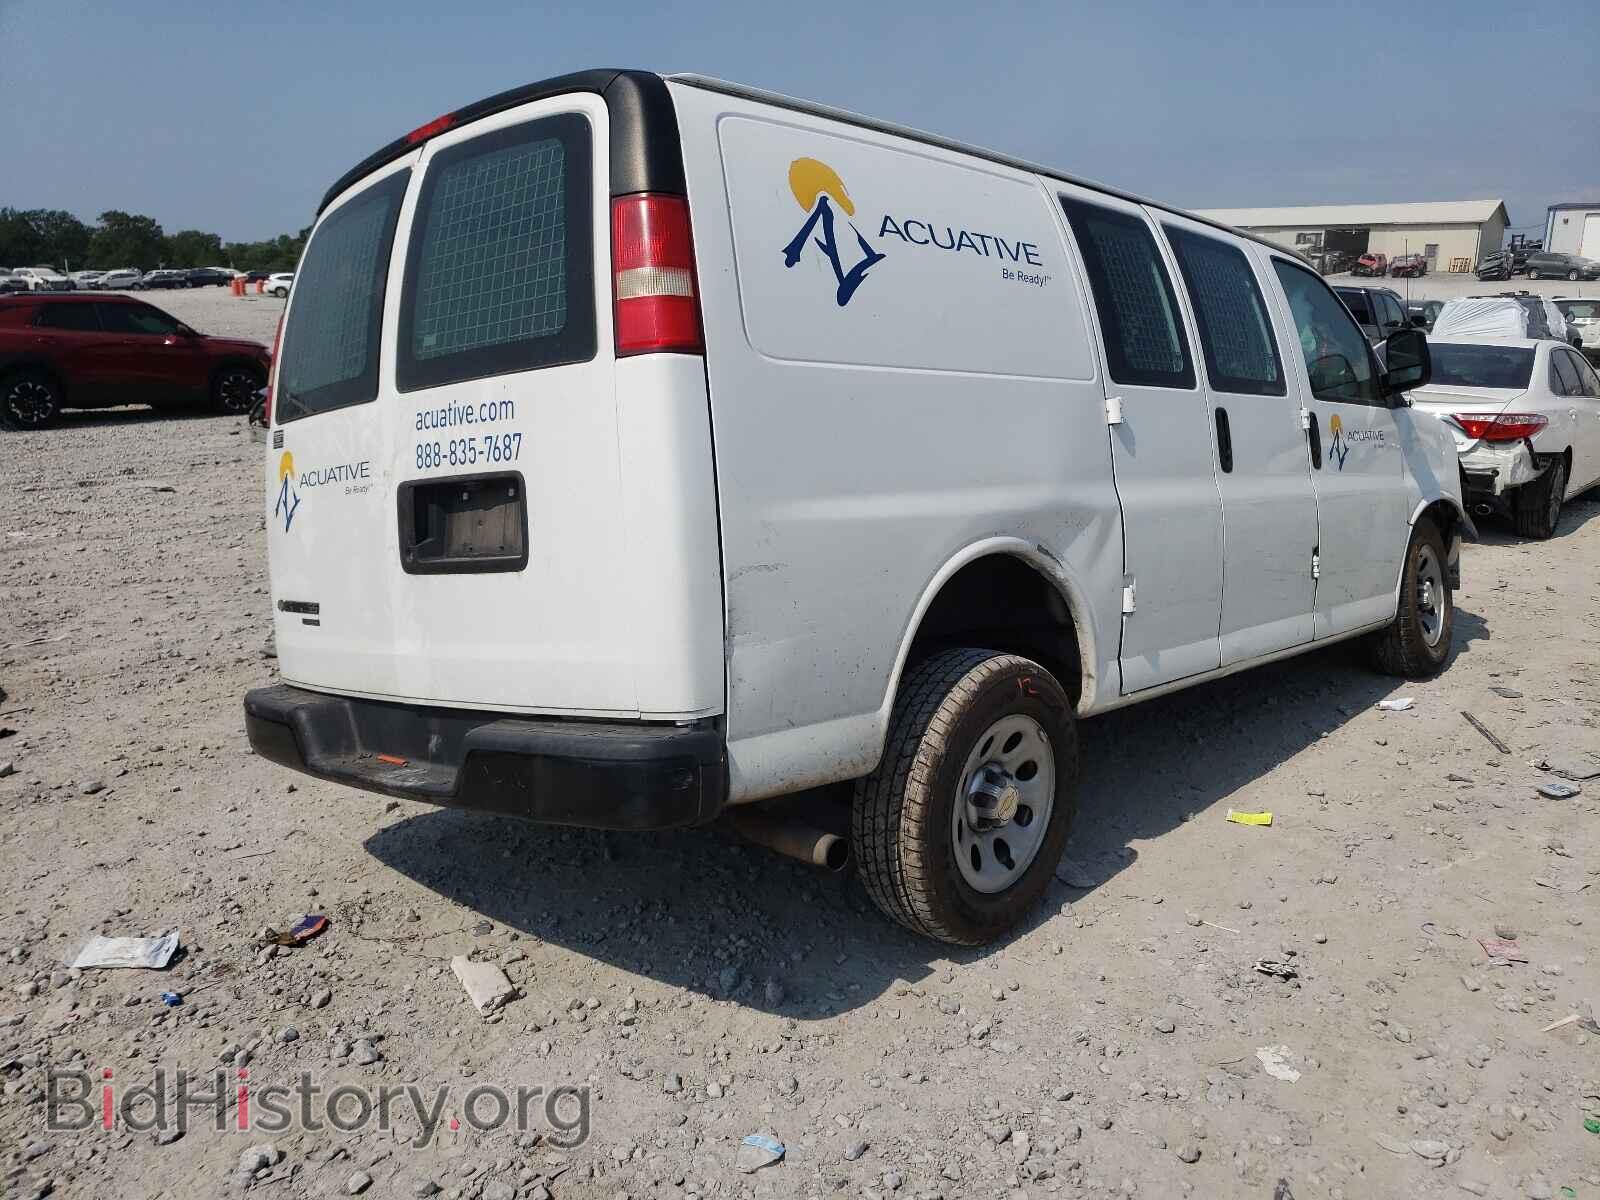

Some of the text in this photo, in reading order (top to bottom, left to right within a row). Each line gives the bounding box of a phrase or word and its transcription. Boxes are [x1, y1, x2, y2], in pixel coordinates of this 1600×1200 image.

[879, 214, 1043, 267] ACUATIVE
[1002, 268, 1015, 281] Be
[415, 400, 515, 431] acuative.com
[1347, 430, 1384, 441] ACUATIVE
[416, 432, 522, 470] 888-835-7687
[299, 460, 370, 489] ACUATIVE
